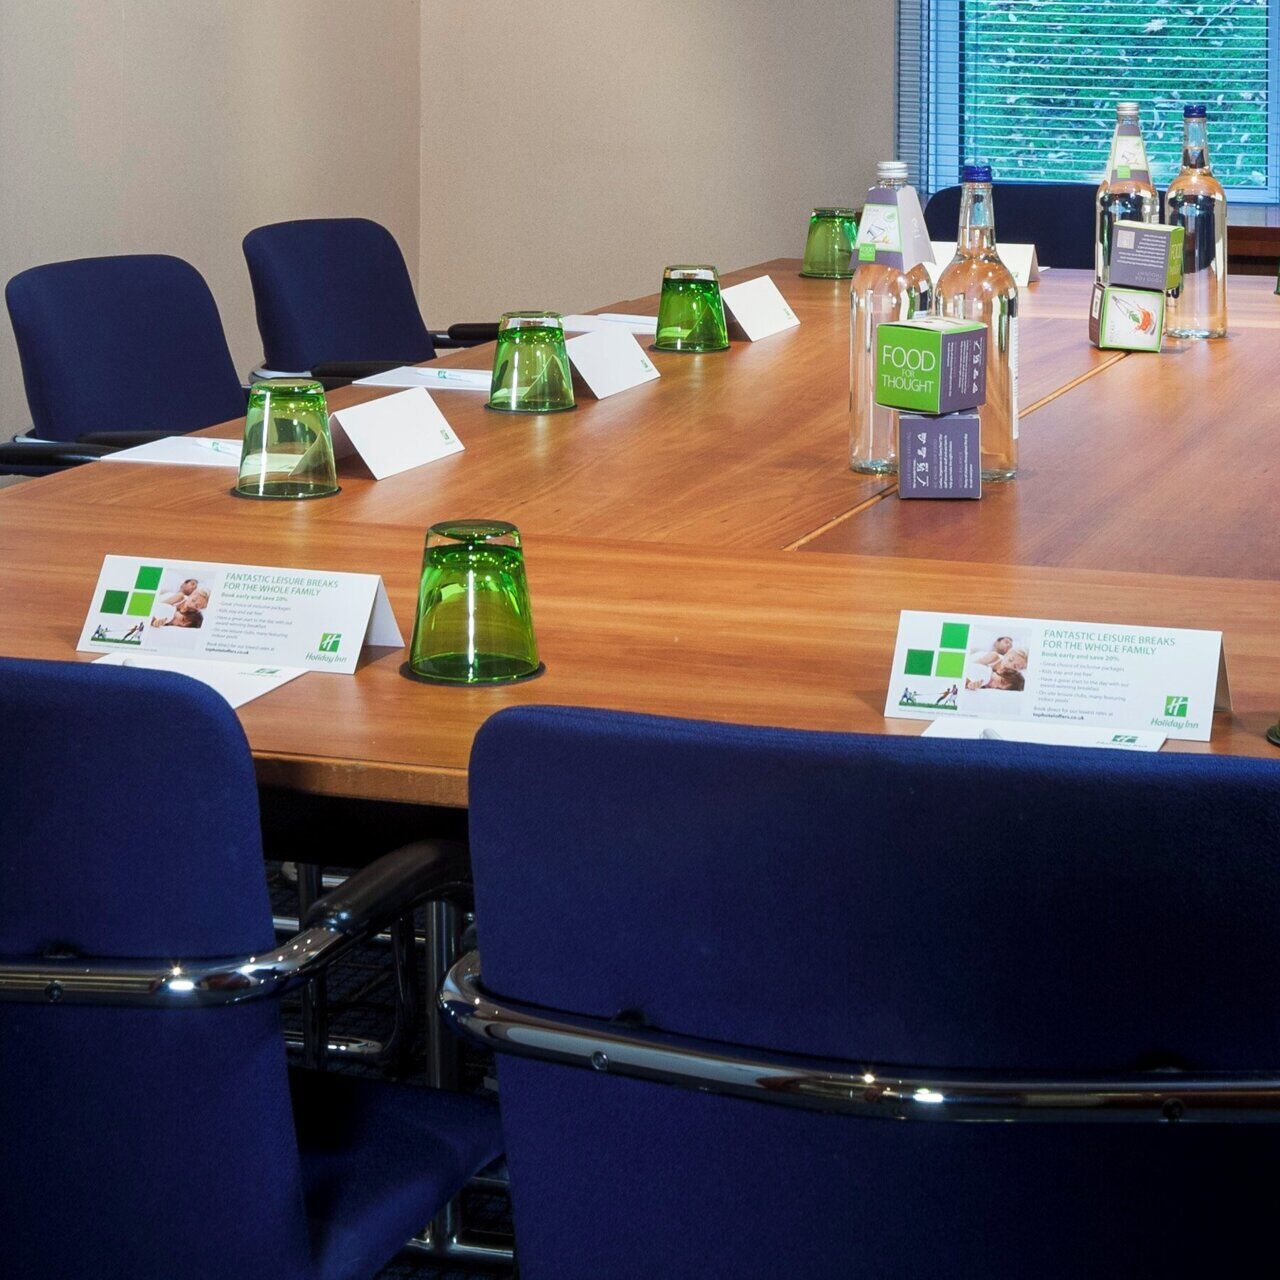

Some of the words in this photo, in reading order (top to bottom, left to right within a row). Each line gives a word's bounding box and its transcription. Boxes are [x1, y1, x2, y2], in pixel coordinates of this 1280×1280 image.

[882, 345, 936, 372] FOOD
[901, 369, 915, 378] FOR
[882, 374, 935, 393] THOUGHT
[226, 572, 270, 583] FANTASTIC
[272, 576, 304, 585] LEISURE
[306, 578, 339, 588] BREAKS
[223, 582, 240, 590] FOR
[242, 583, 257, 591] THE
[259, 585, 289, 594] WHOLE
[290, 587, 322, 596] FAMILY
[1044, 629, 1095, 640] FANTASTIC
[1097, 633, 1136, 643] LEISURE
[1138, 635, 1176, 646] BREAKS
[1043, 640, 1063, 649] FOR
[1065, 641, 1084, 650] THE
[1084, 643, 1119, 653] WHOLE
[1122, 645, 1157, 655] FAMILY
[305, 652, 334, 663] Holiday
[334, 654, 347, 663] Inn
[1150, 717, 1184, 730] Holiday
[1185, 720, 1199, 729] Inn
